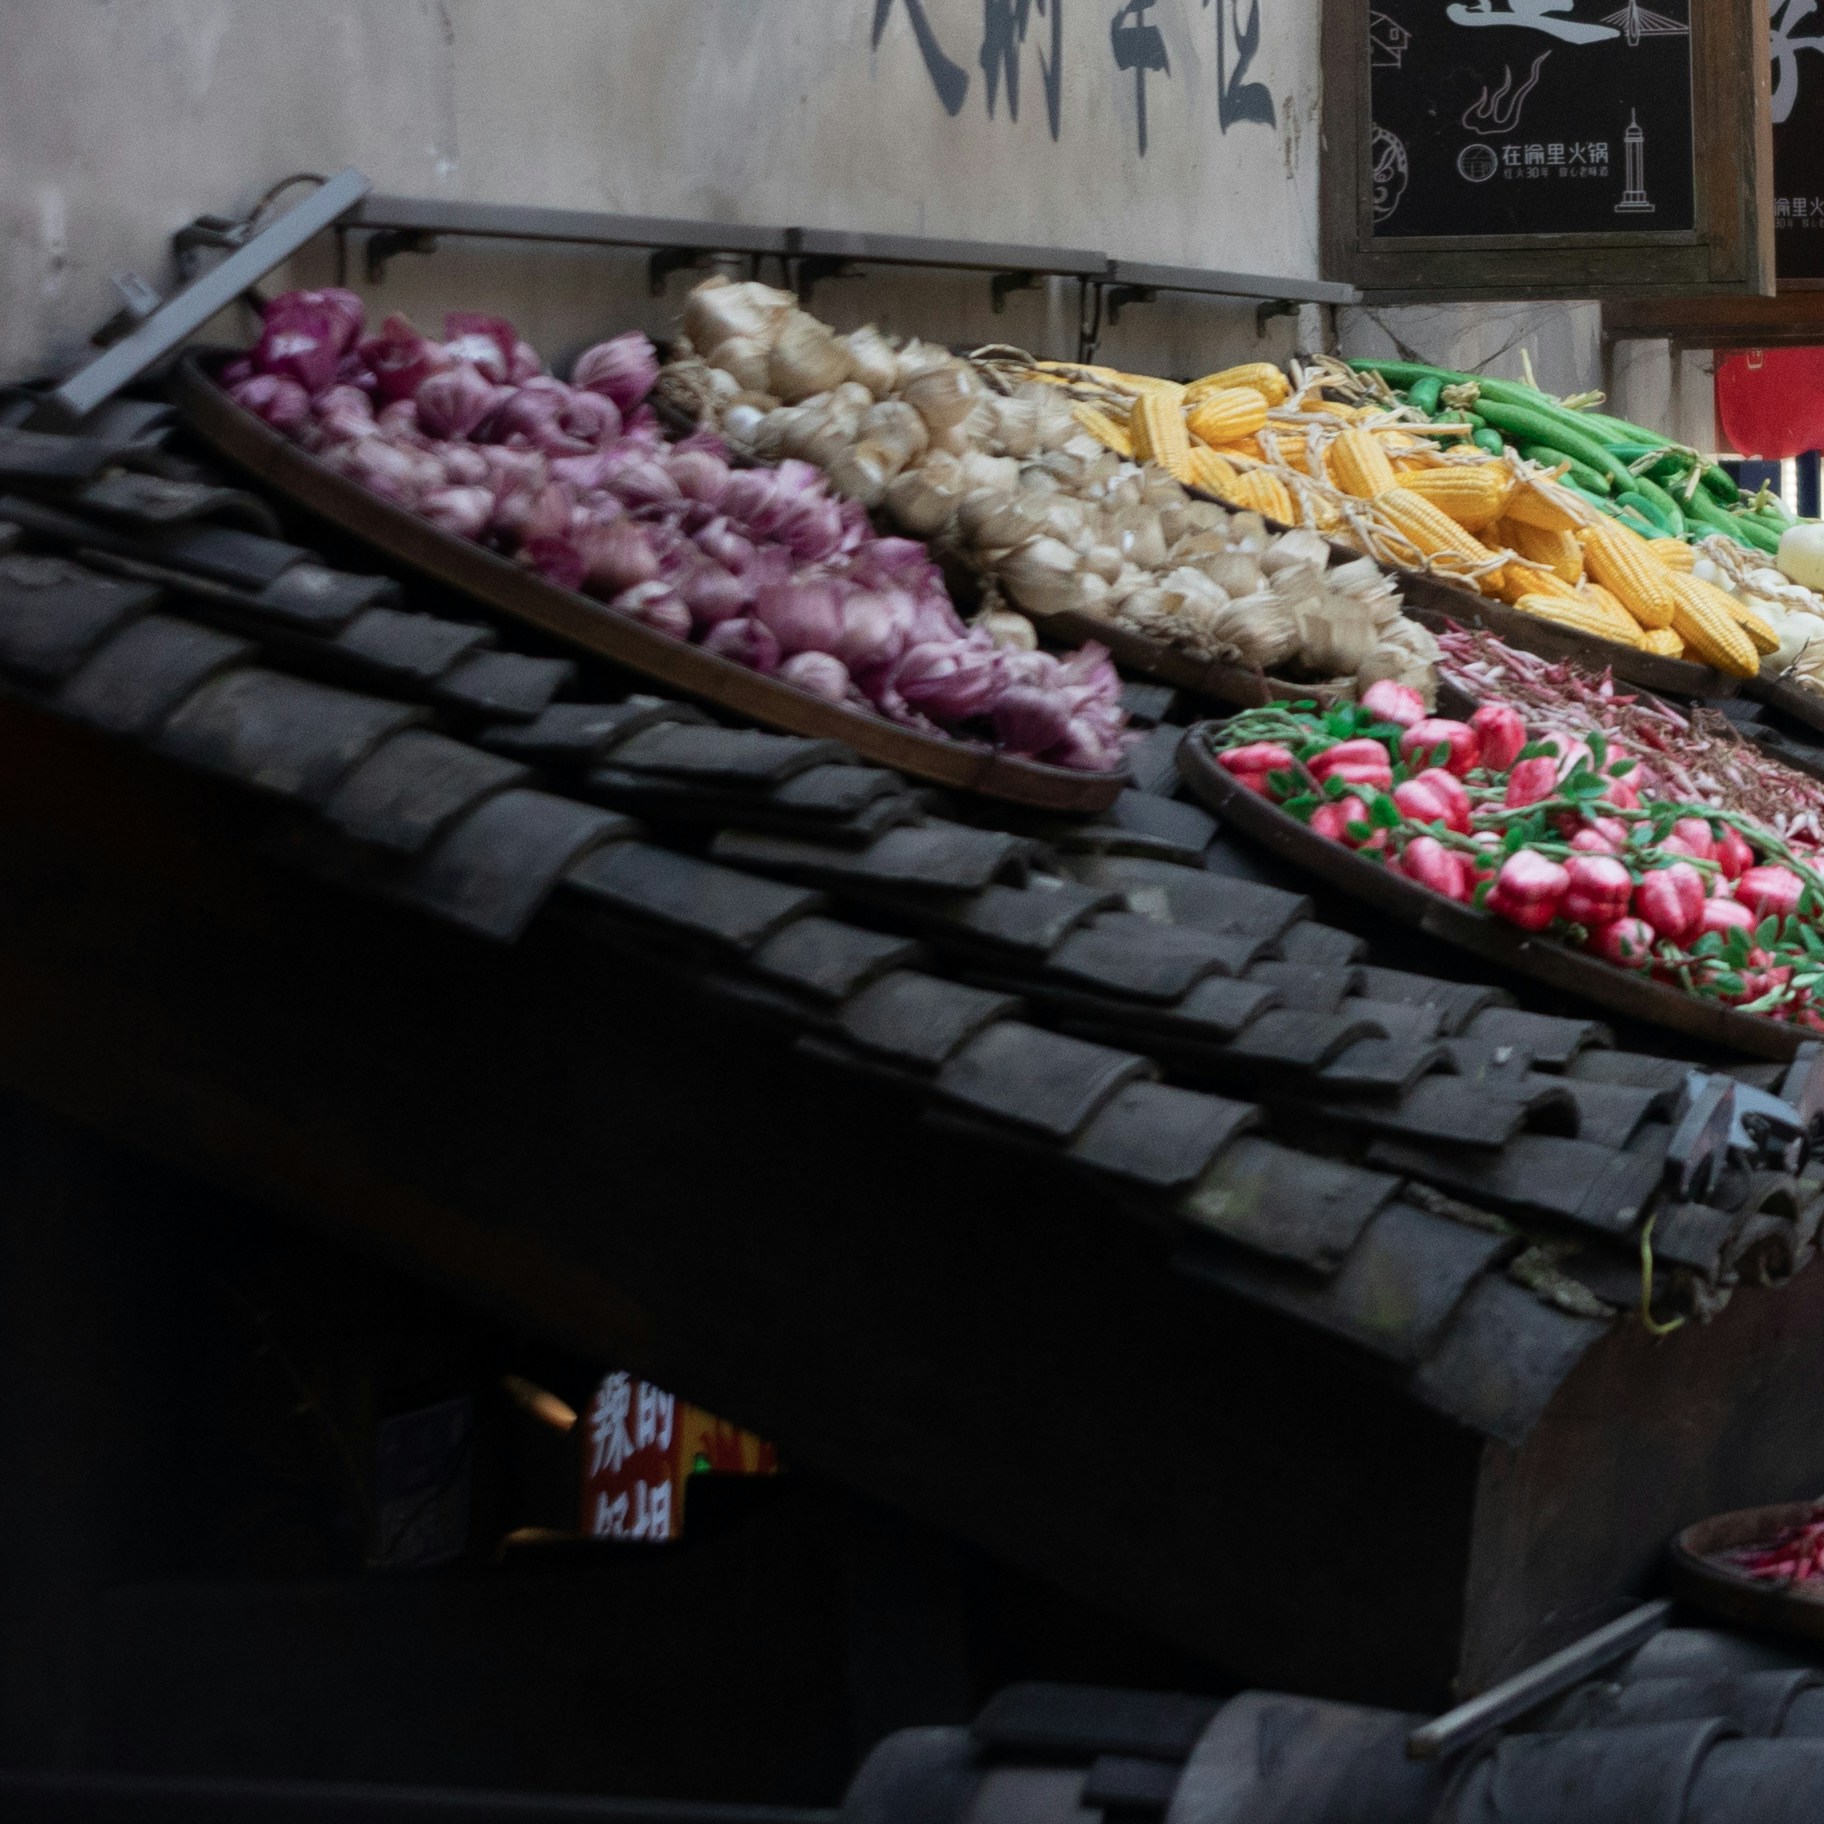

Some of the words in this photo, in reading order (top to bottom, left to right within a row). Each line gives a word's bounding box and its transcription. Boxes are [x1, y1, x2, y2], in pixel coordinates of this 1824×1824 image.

[1501, 141, 1609, 165] 在渝里火锅
